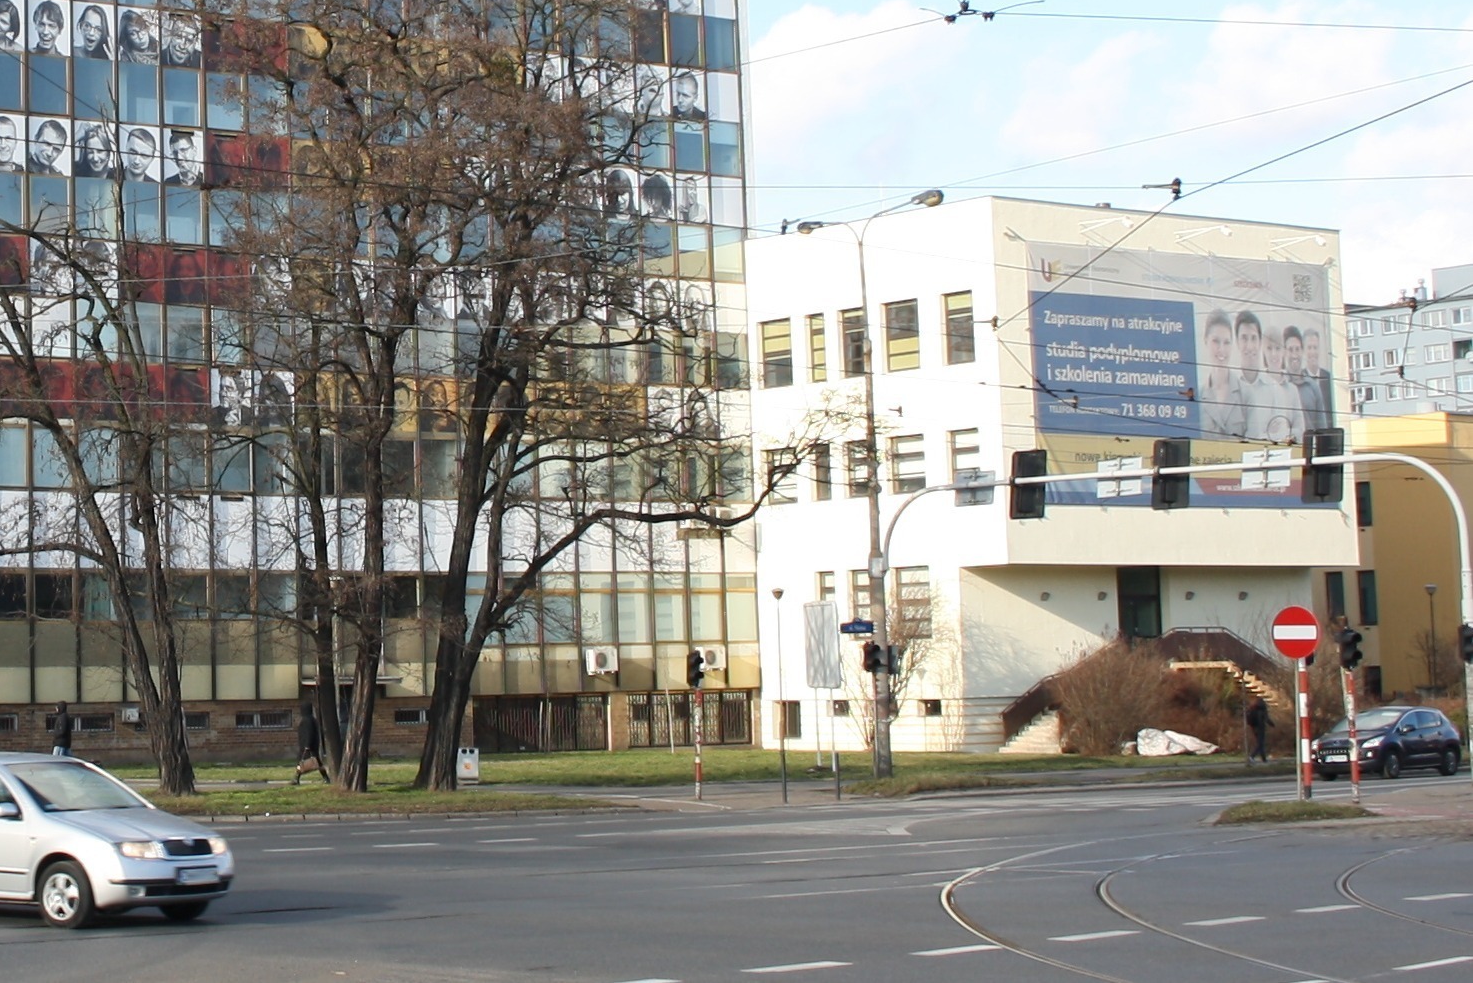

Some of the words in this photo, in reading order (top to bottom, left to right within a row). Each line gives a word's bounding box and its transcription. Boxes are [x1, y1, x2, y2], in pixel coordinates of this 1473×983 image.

[1044, 310, 1109, 330] Zapraszamy
[1111, 317, 1125, 328] na
[1128, 317, 1183, 334] atrakcyjne
[1046, 341, 1085, 359] studia
[1089, 343, 1179, 364] podyplomowe
[1047, 364, 1052, 381] i
[1055, 364, 1112, 384] szkolenia
[1115, 370, 1185, 387] zamawiane
[1121, 403, 1134, 416] 71
[1136, 404, 1156, 417] 368
[1158, 405, 1172, 418] 09
[1174, 405, 1187, 418] 49
